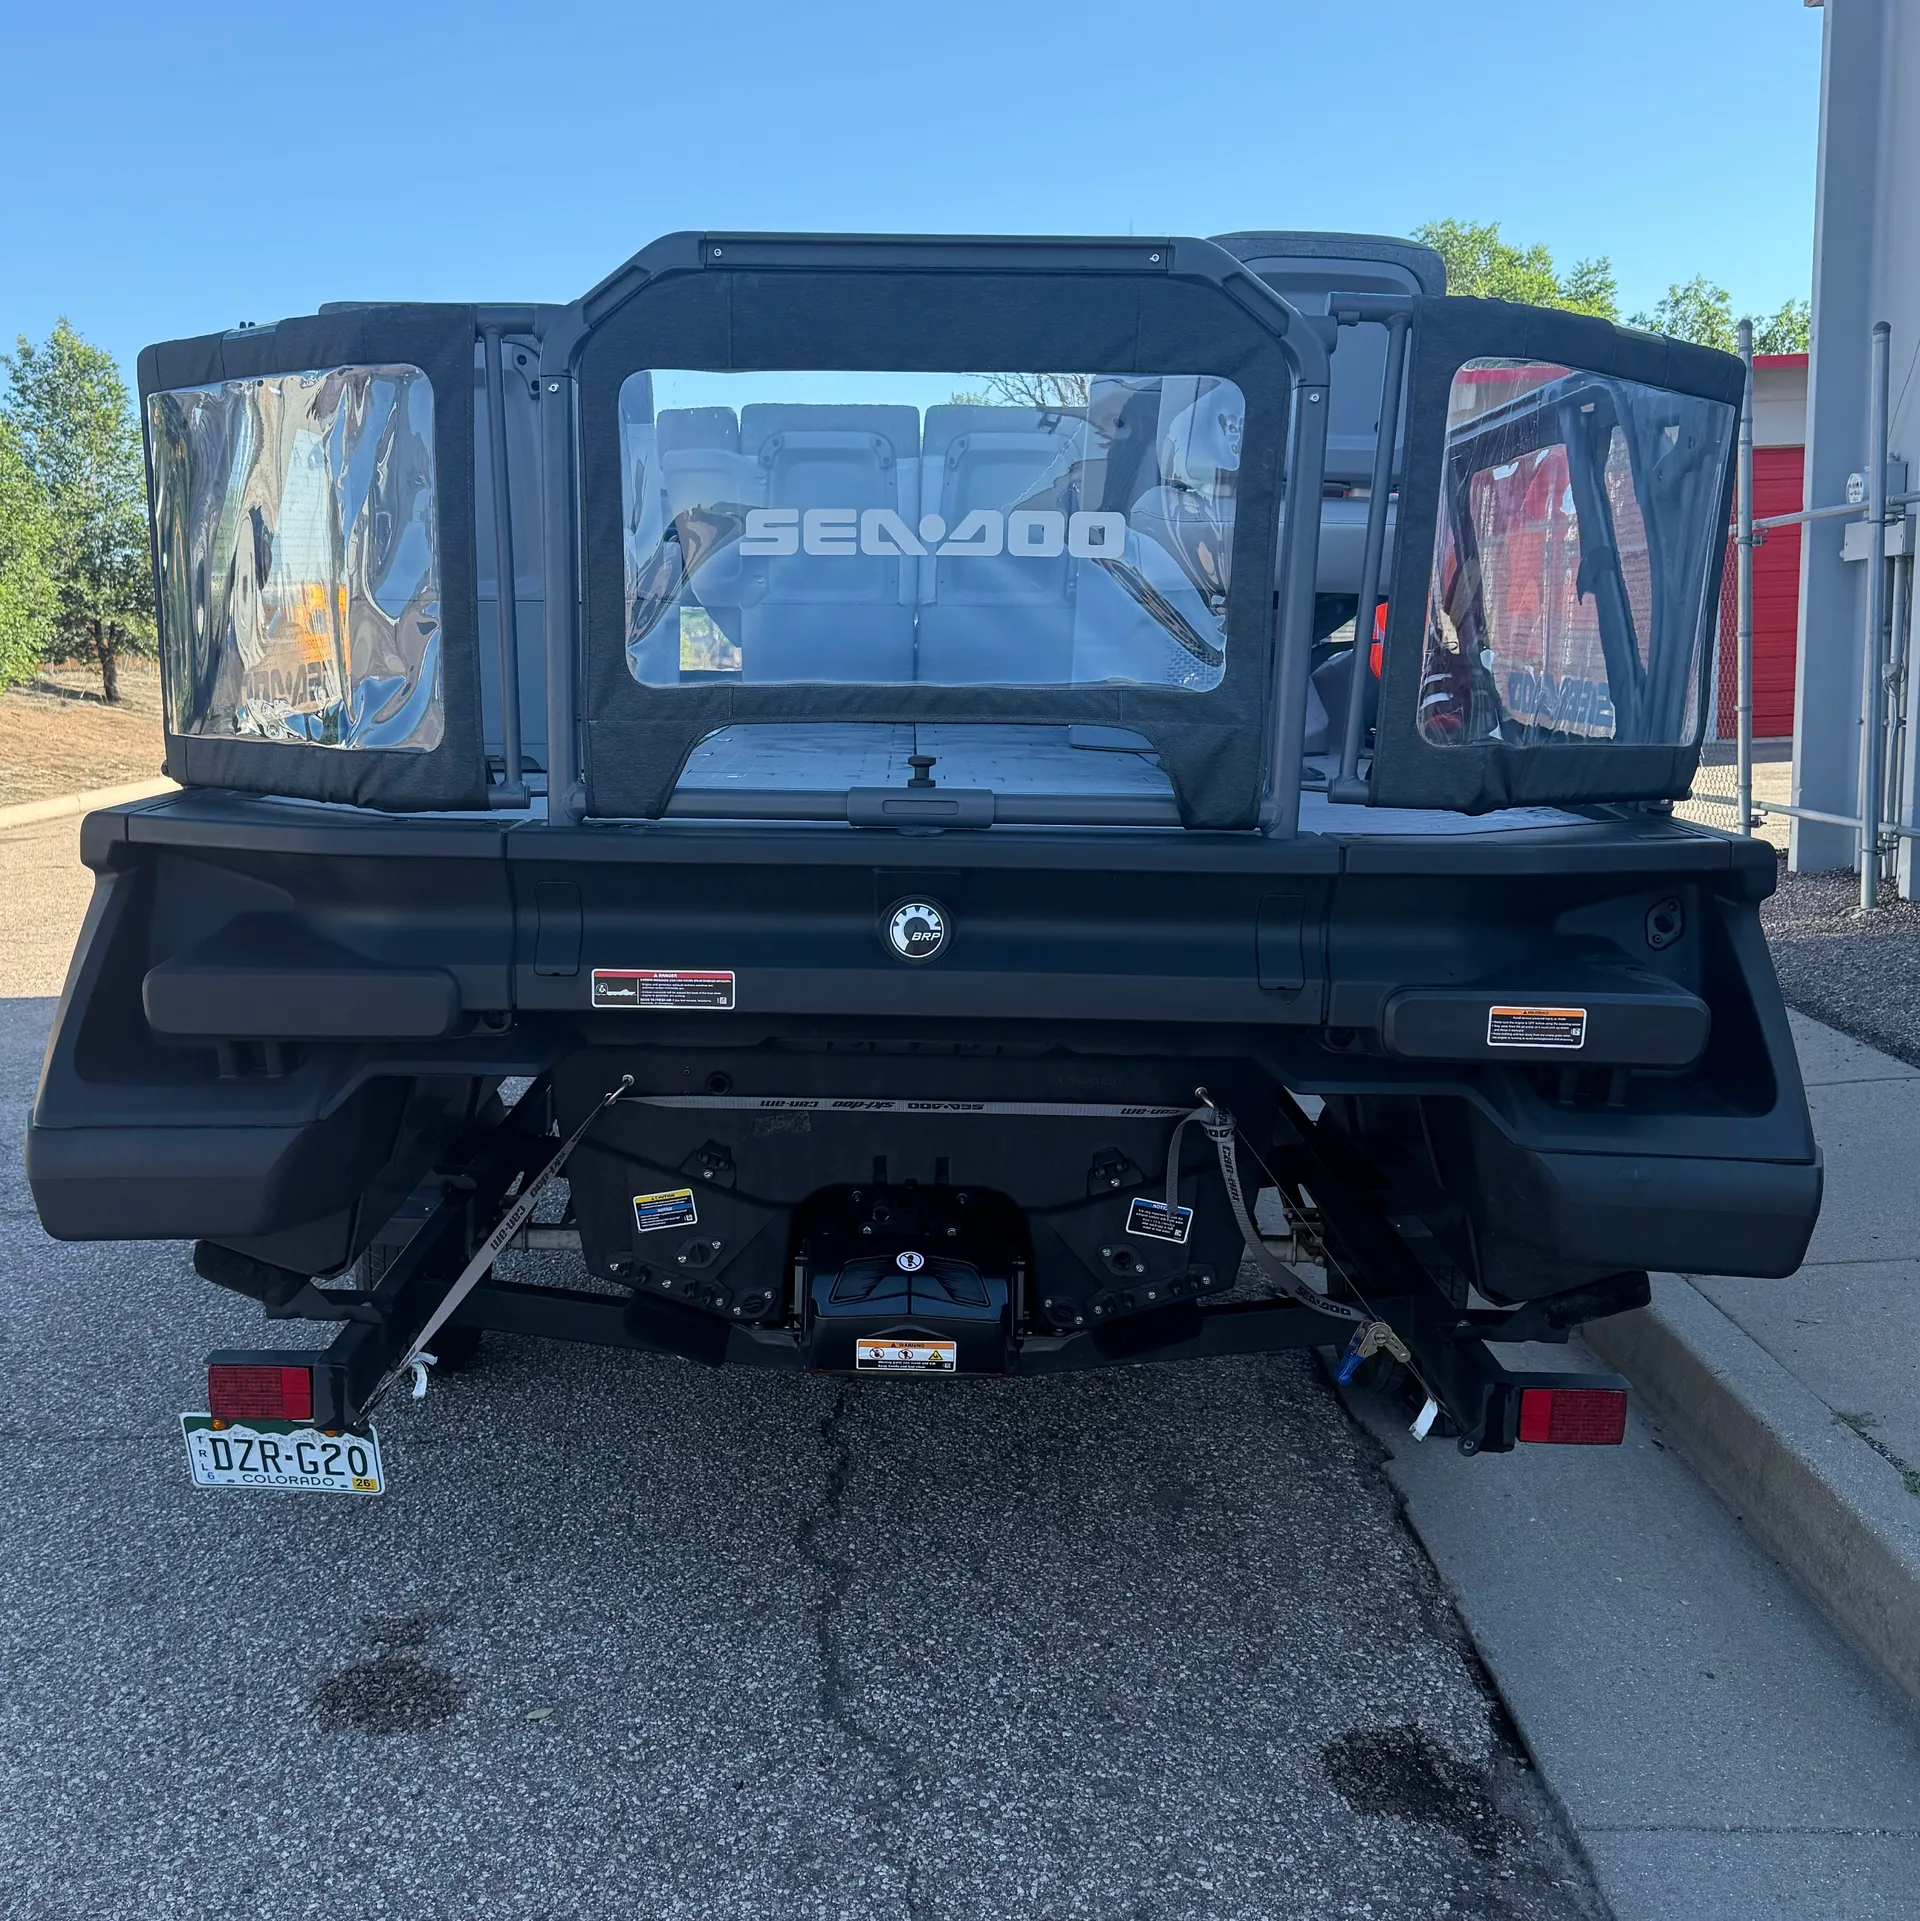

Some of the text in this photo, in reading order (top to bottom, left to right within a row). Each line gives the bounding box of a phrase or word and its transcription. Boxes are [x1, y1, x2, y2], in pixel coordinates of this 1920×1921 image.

[911, 931, 941, 941] BRP
[759, 1100, 819, 1108] can-am
[831, 1101, 896, 1110] ski-doo
[1120, 1107, 1180, 1115] can-am
[1221, 1144, 1240, 1202] can-am
[490, 1204, 526, 1251] can-am
[208, 1437, 368, 1477] DZR-G20
[207, 1471, 215, 1480] 6
[242, 1473, 335, 1487] COLORADO
[356, 1478, 371, 1487] 26
